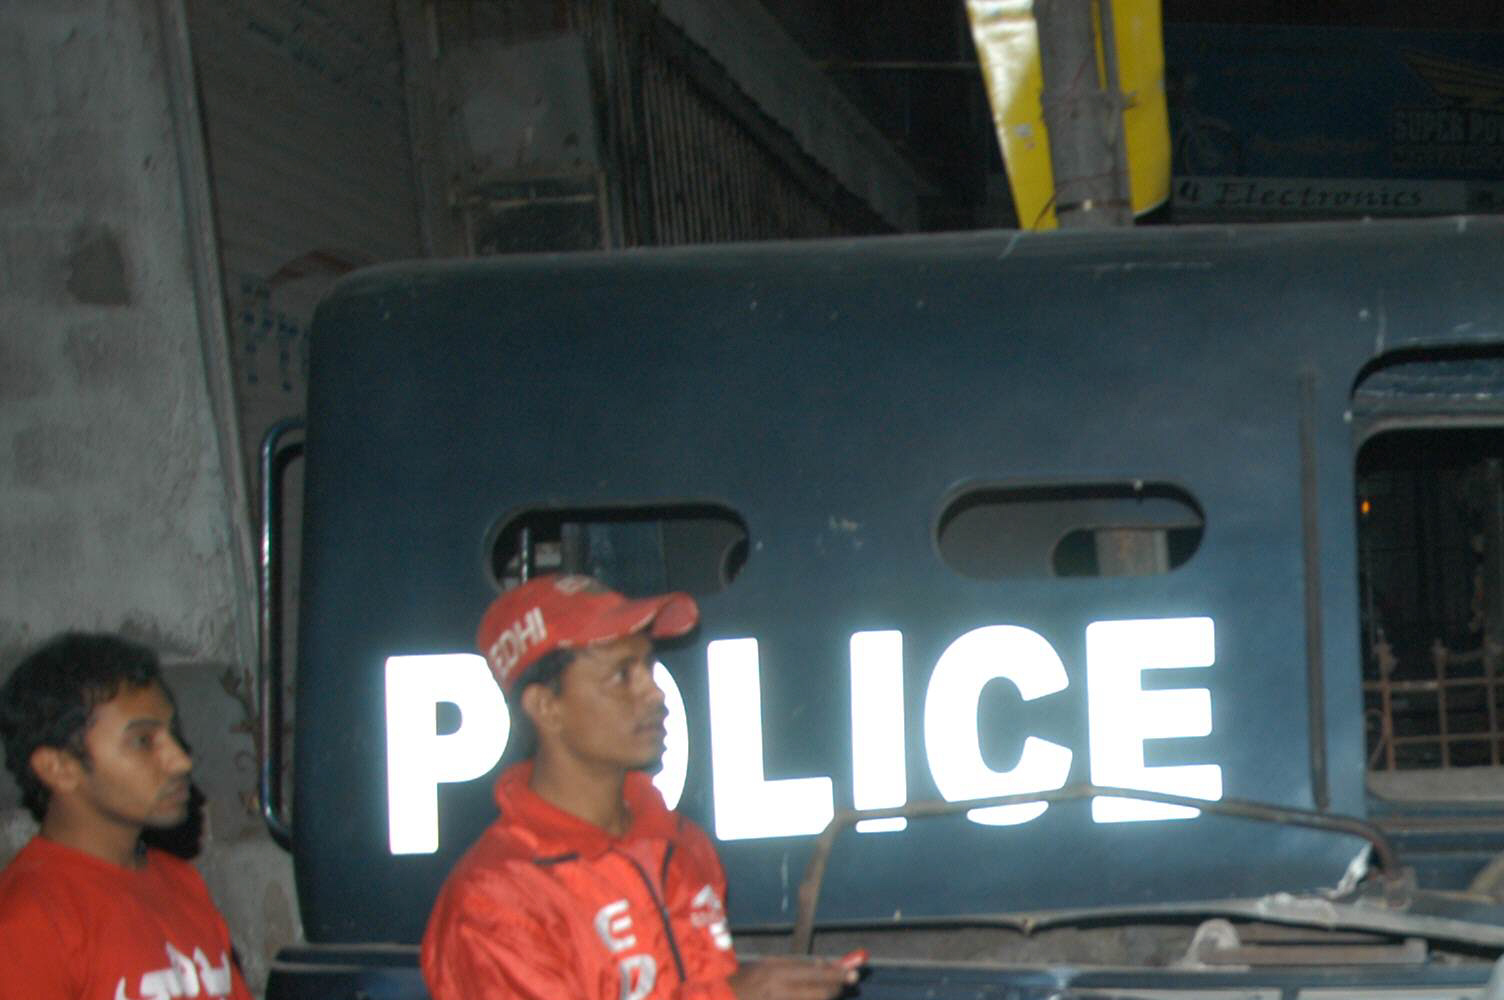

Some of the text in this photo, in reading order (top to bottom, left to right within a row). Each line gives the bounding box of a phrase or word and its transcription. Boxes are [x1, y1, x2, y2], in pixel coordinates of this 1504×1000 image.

[1214, 181, 1422, 206] Electronics
[488, 606, 548, 680] EDHI
[384, 616, 1224, 855] PLICE
